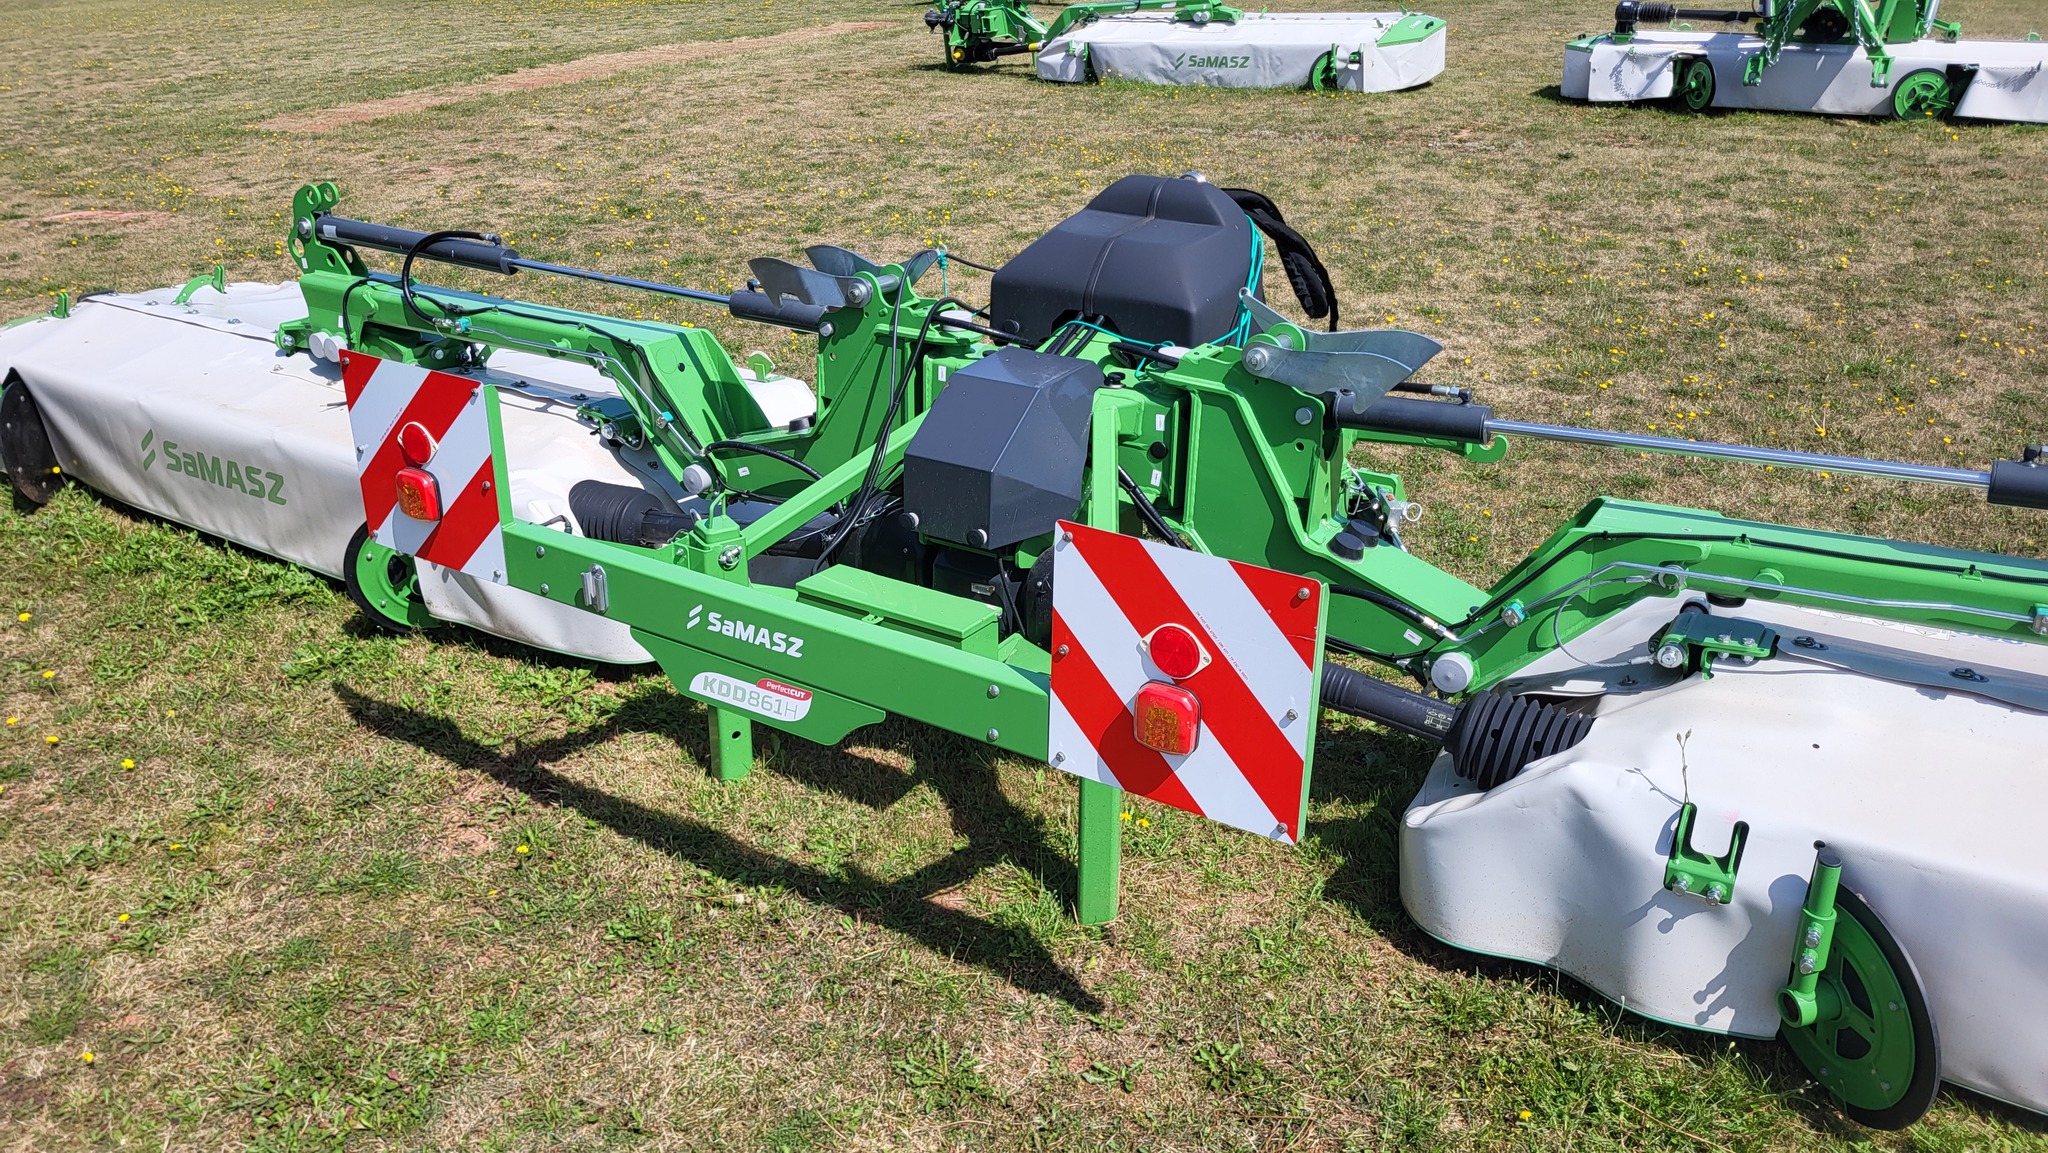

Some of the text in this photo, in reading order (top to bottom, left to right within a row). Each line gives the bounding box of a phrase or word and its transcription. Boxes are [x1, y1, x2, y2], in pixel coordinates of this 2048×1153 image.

[1188, 55, 1250, 69] SaMASZ
[163, 440, 287, 506] SaMASZ
[707, 611, 804, 658] SaMASZ
[702, 675, 798, 720] KDD861H
